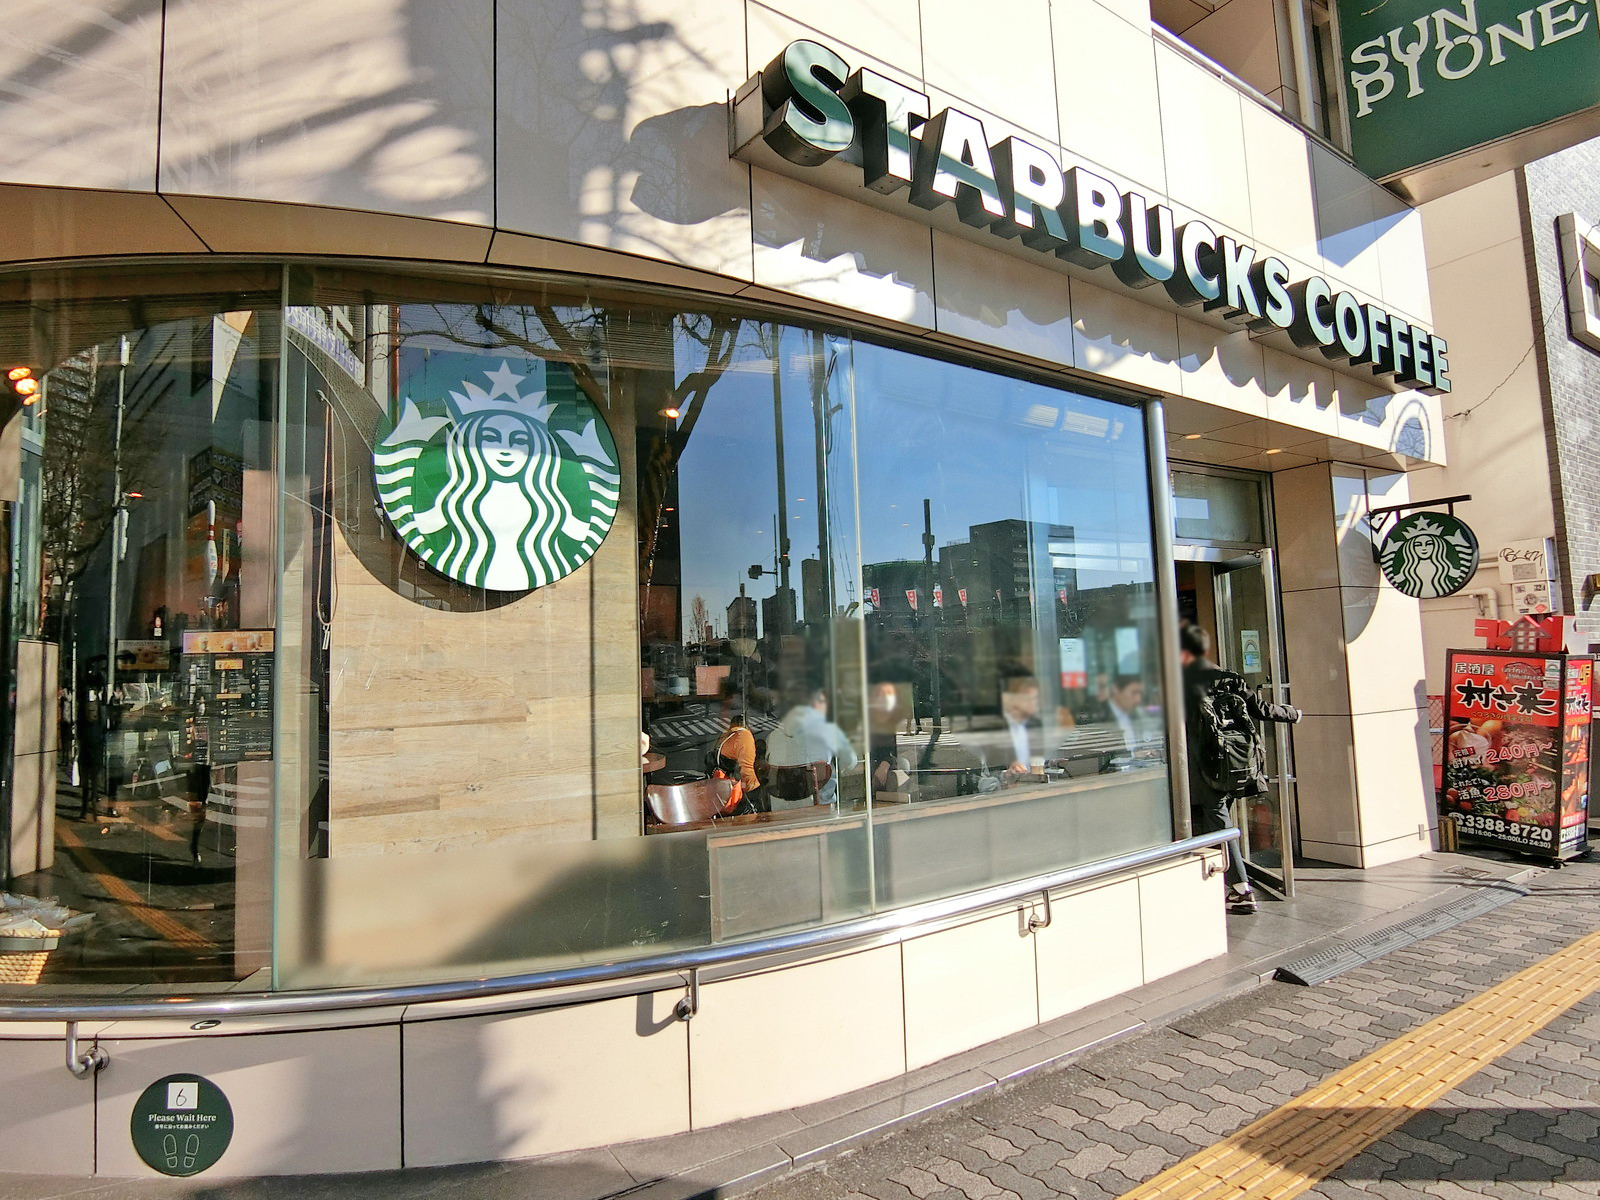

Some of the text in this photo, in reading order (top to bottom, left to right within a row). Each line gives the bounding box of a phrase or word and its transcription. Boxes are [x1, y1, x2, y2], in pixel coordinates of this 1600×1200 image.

[766, 38, 1452, 394] STARBUCKS COFFEE
[1455, 662, 1495, 676] 居酒屋
[1454, 678, 1558, 716] 村さ来
[176, 1088, 187, 1106] 6
[148, 1113, 217, 1122] Please Wait Here
